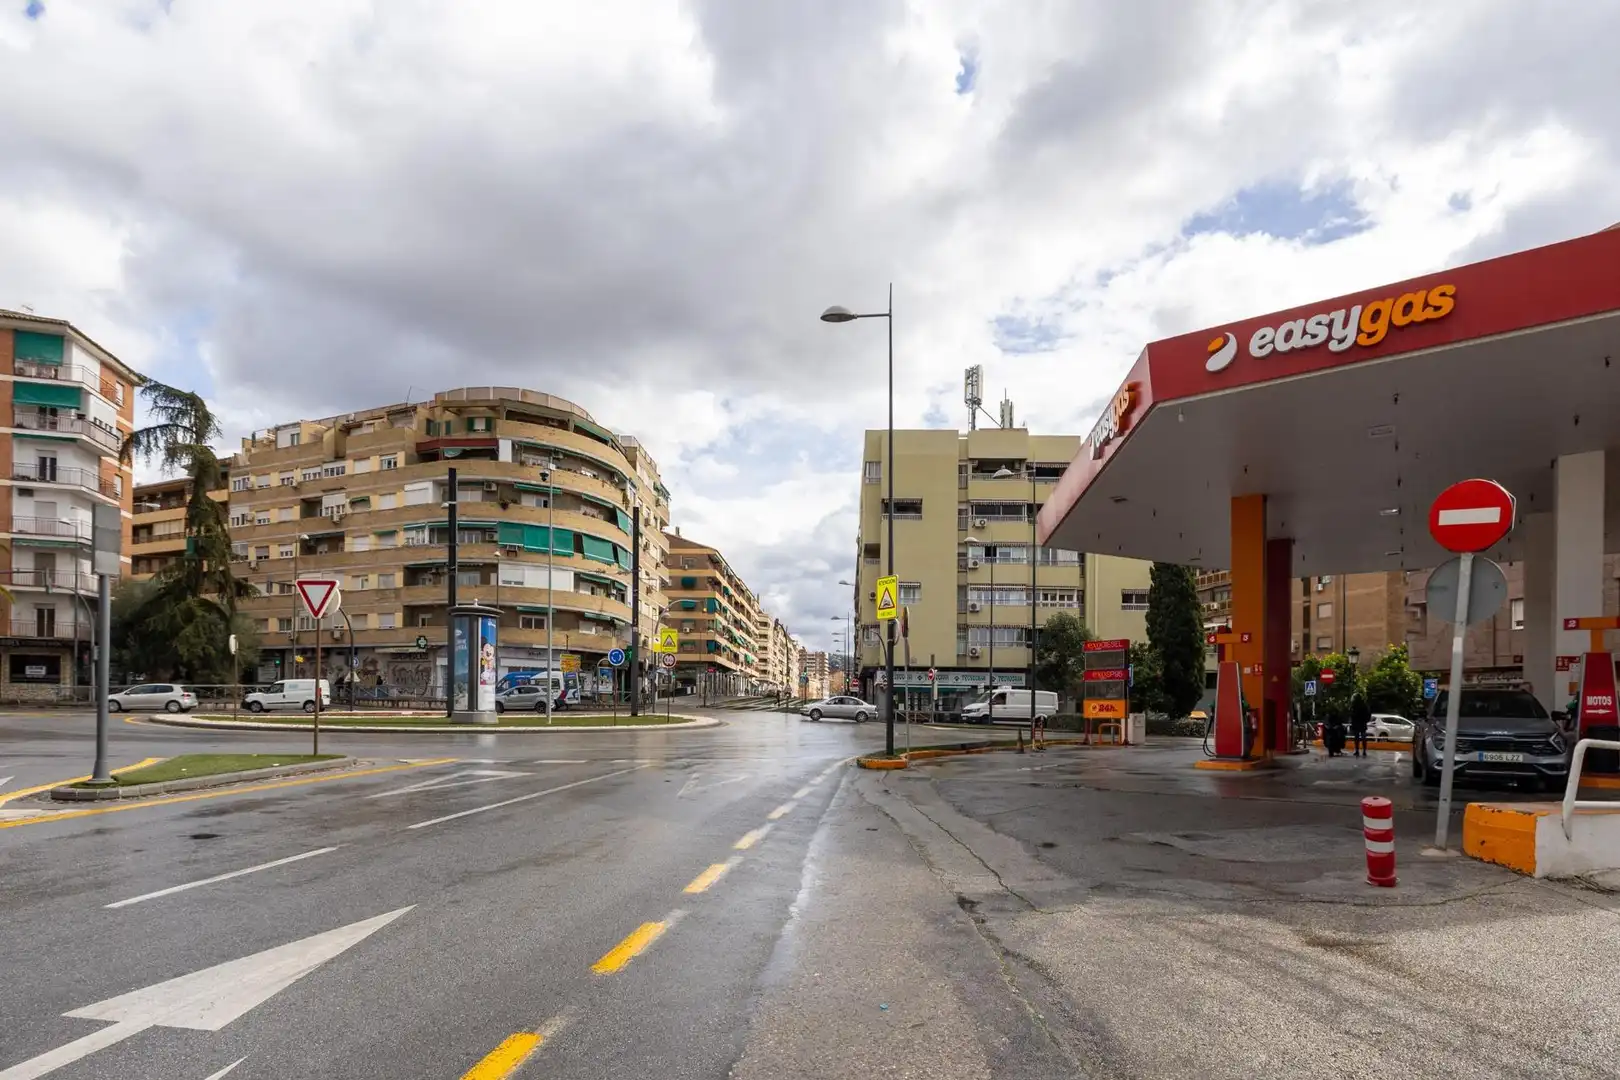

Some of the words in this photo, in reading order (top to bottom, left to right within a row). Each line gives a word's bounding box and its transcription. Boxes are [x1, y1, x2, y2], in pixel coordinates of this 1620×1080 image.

[1249, 284, 1456, 358] easygas
[1095, 383, 1130, 448] easygas
[1567, 620, 1576, 628] 2
[1586, 695, 1612, 706] MOTOS
